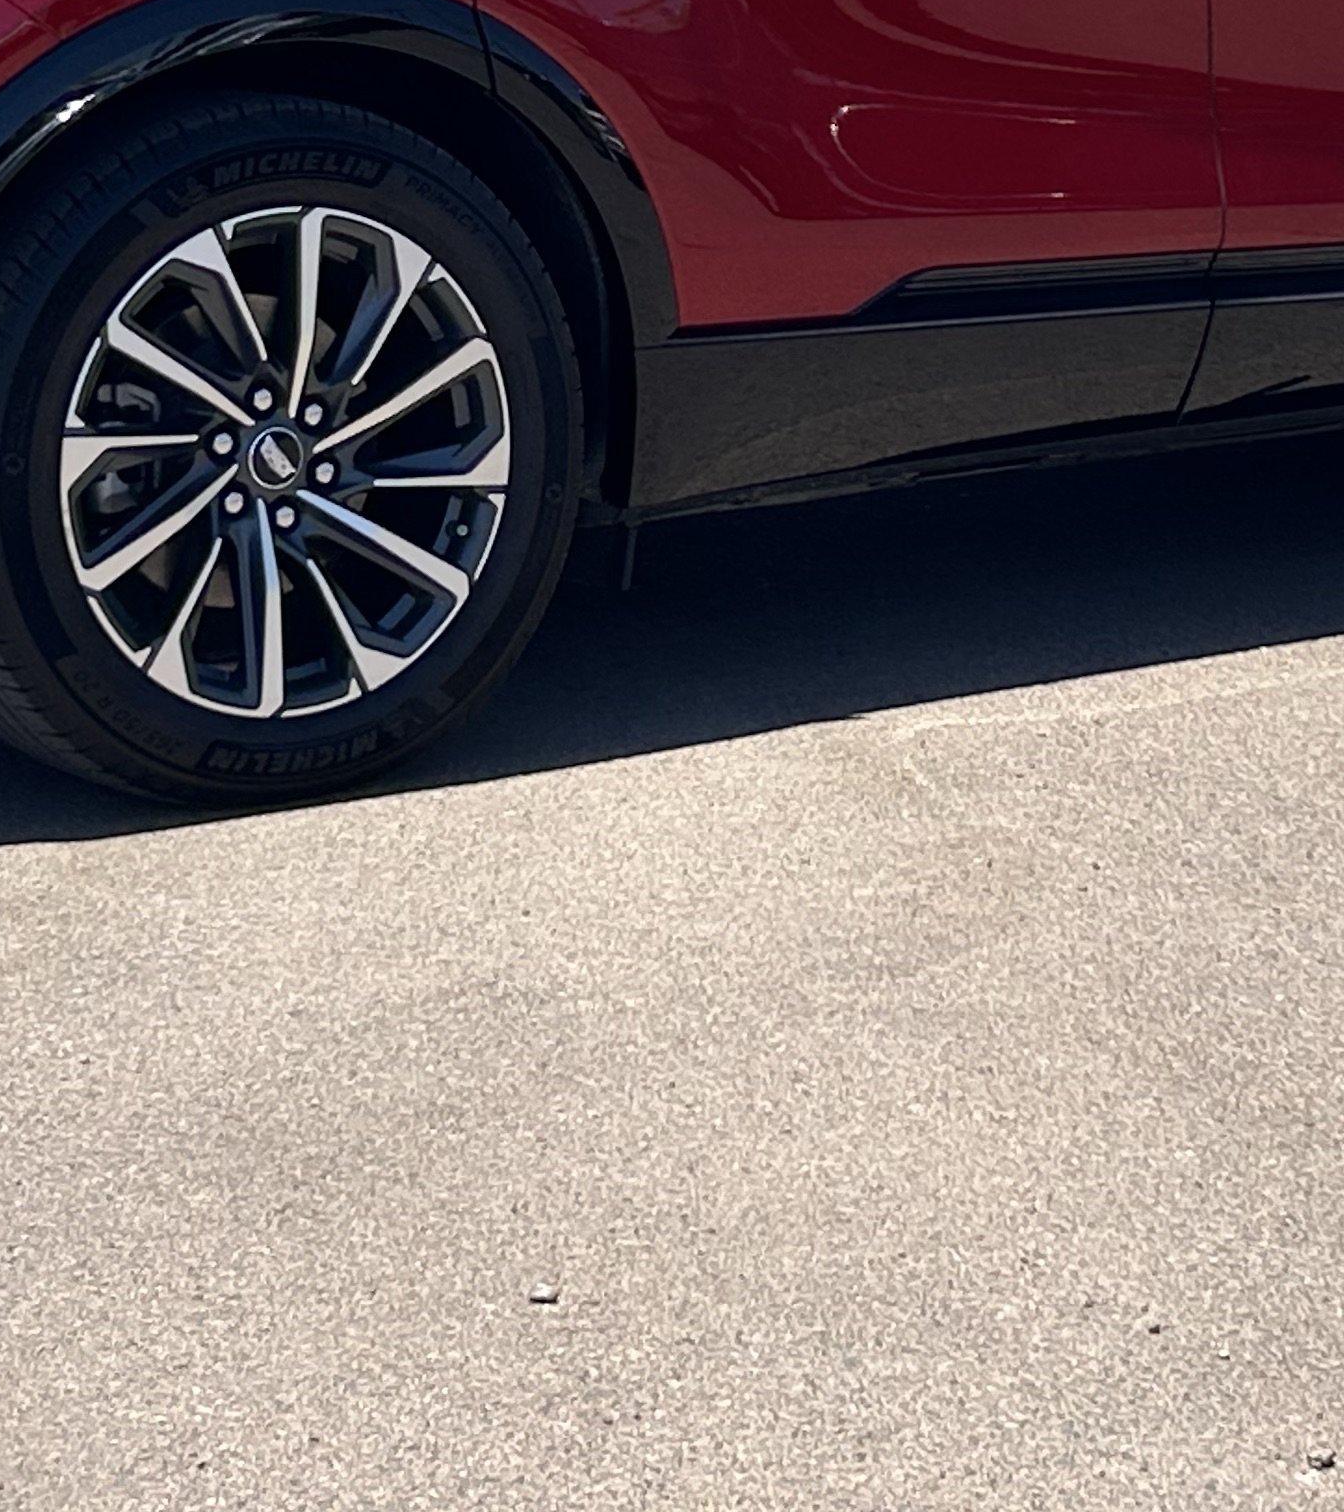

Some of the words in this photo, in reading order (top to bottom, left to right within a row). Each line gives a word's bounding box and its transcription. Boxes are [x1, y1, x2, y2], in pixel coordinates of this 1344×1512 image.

[212, 151, 382, 187] MICHELIN
[404, 174, 486, 235] PRIMACY
[211, 730, 380, 773] MICHELIN
